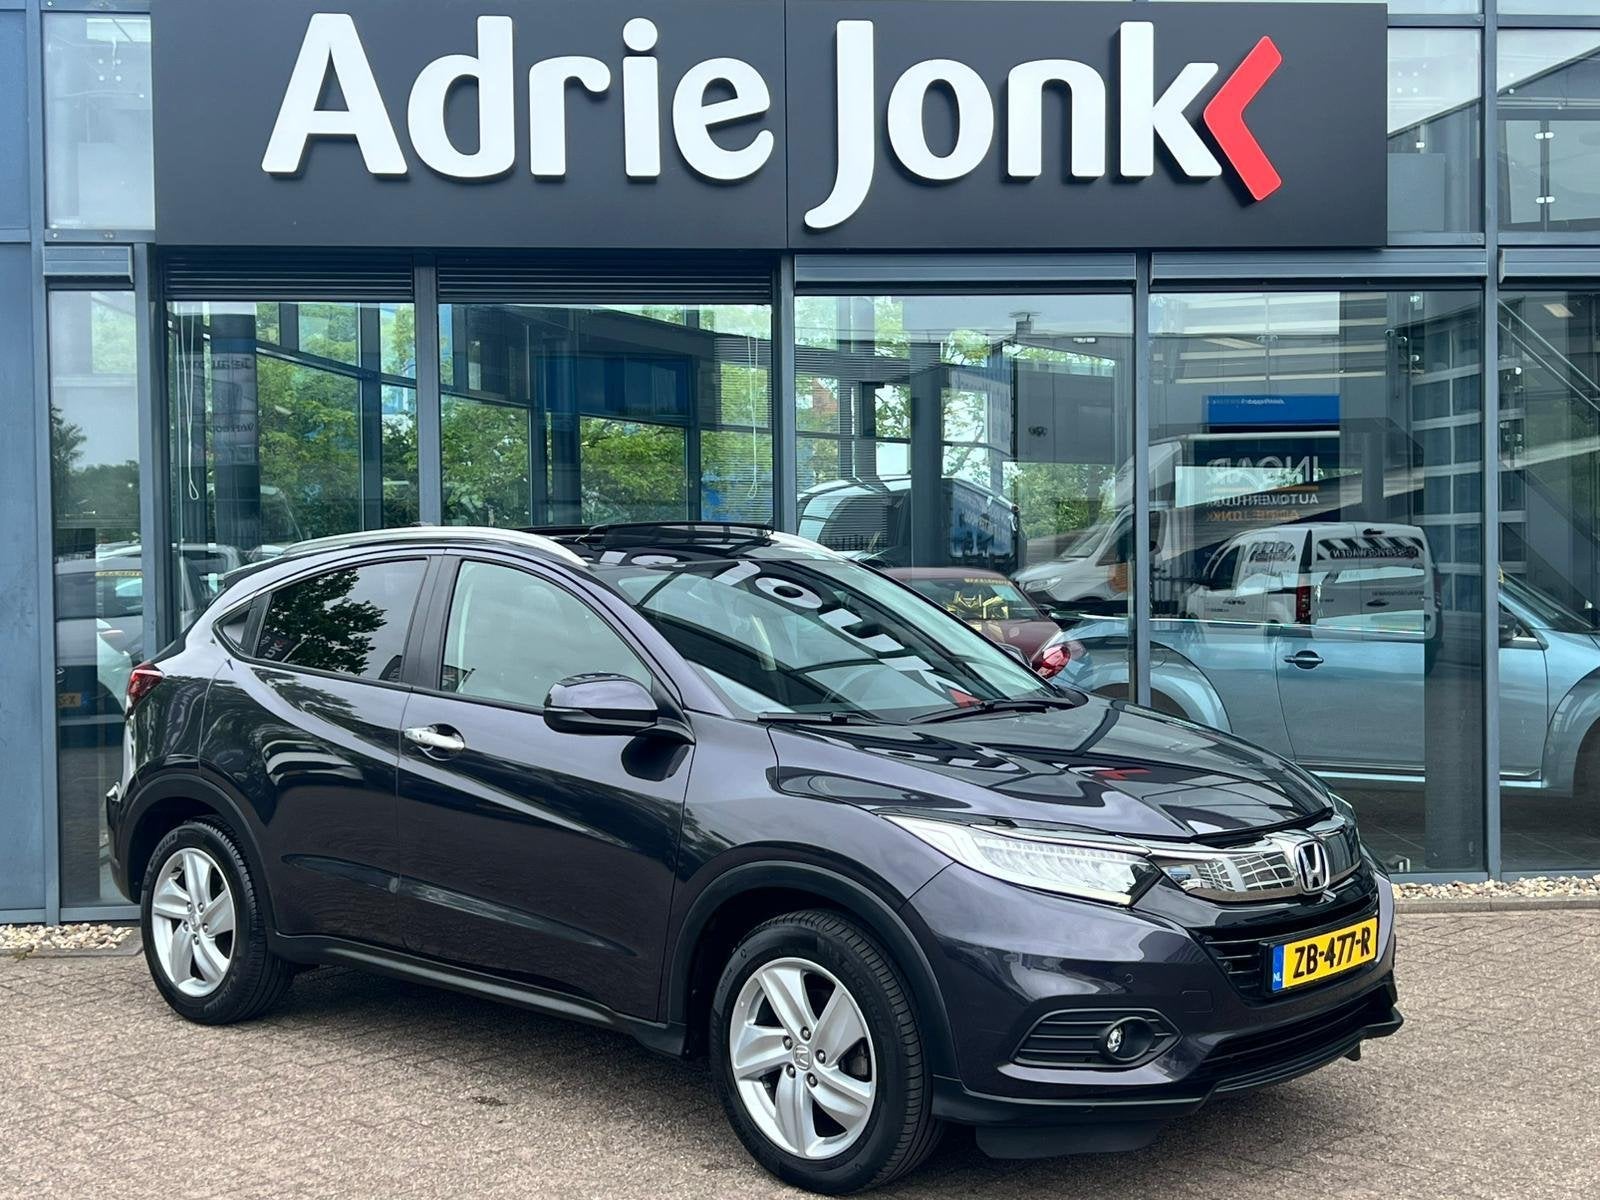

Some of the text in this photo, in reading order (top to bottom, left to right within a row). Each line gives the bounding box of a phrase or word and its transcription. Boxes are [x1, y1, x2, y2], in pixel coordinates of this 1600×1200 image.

[261, 13, 1222, 229] Adrie Jonk
[1273, 972, 1282, 983] NL
[1293, 927, 1370, 979] ZB-477-R
